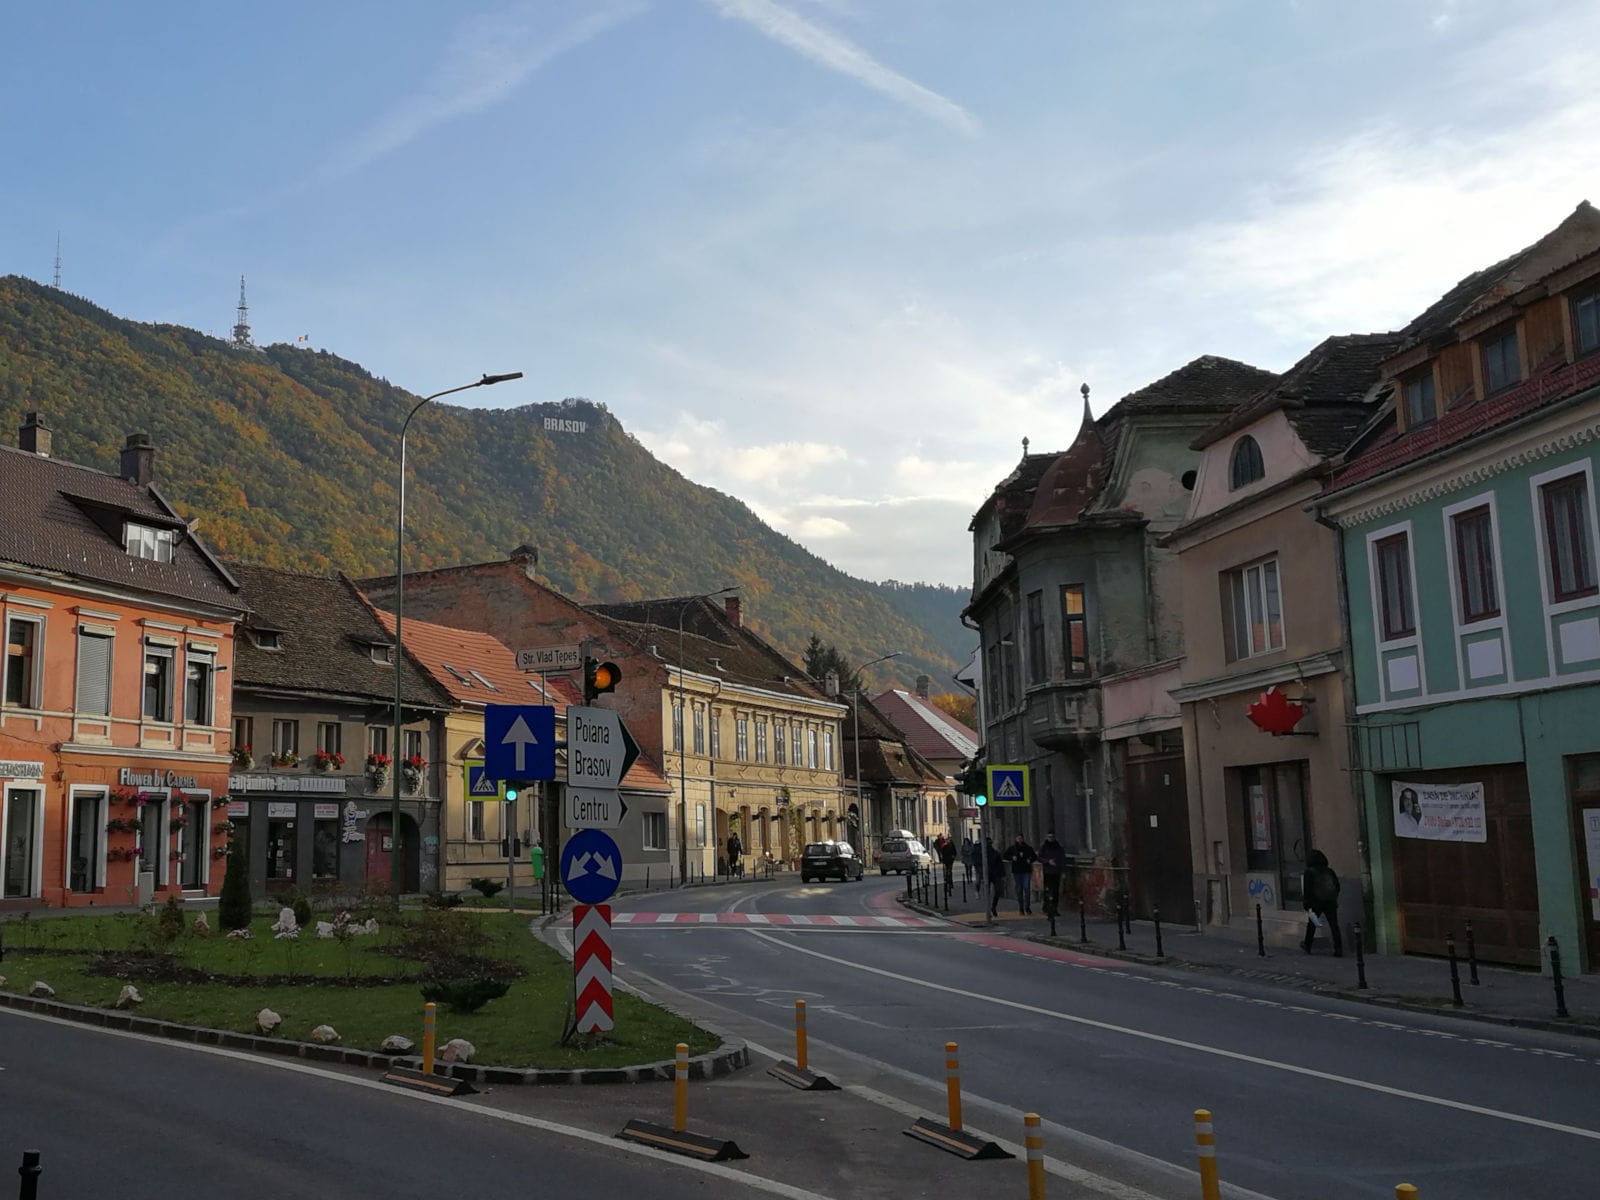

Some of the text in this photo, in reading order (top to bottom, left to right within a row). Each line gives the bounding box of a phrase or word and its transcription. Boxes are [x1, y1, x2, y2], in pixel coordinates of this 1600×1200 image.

[543, 417, 586, 433] BRASOV
[523, 653, 535, 665] Str.
[537, 650, 553, 663] Vlad
[575, 716, 610, 745] Poiana
[154, 768, 165, 788] by
[572, 795, 609, 822] Centru
